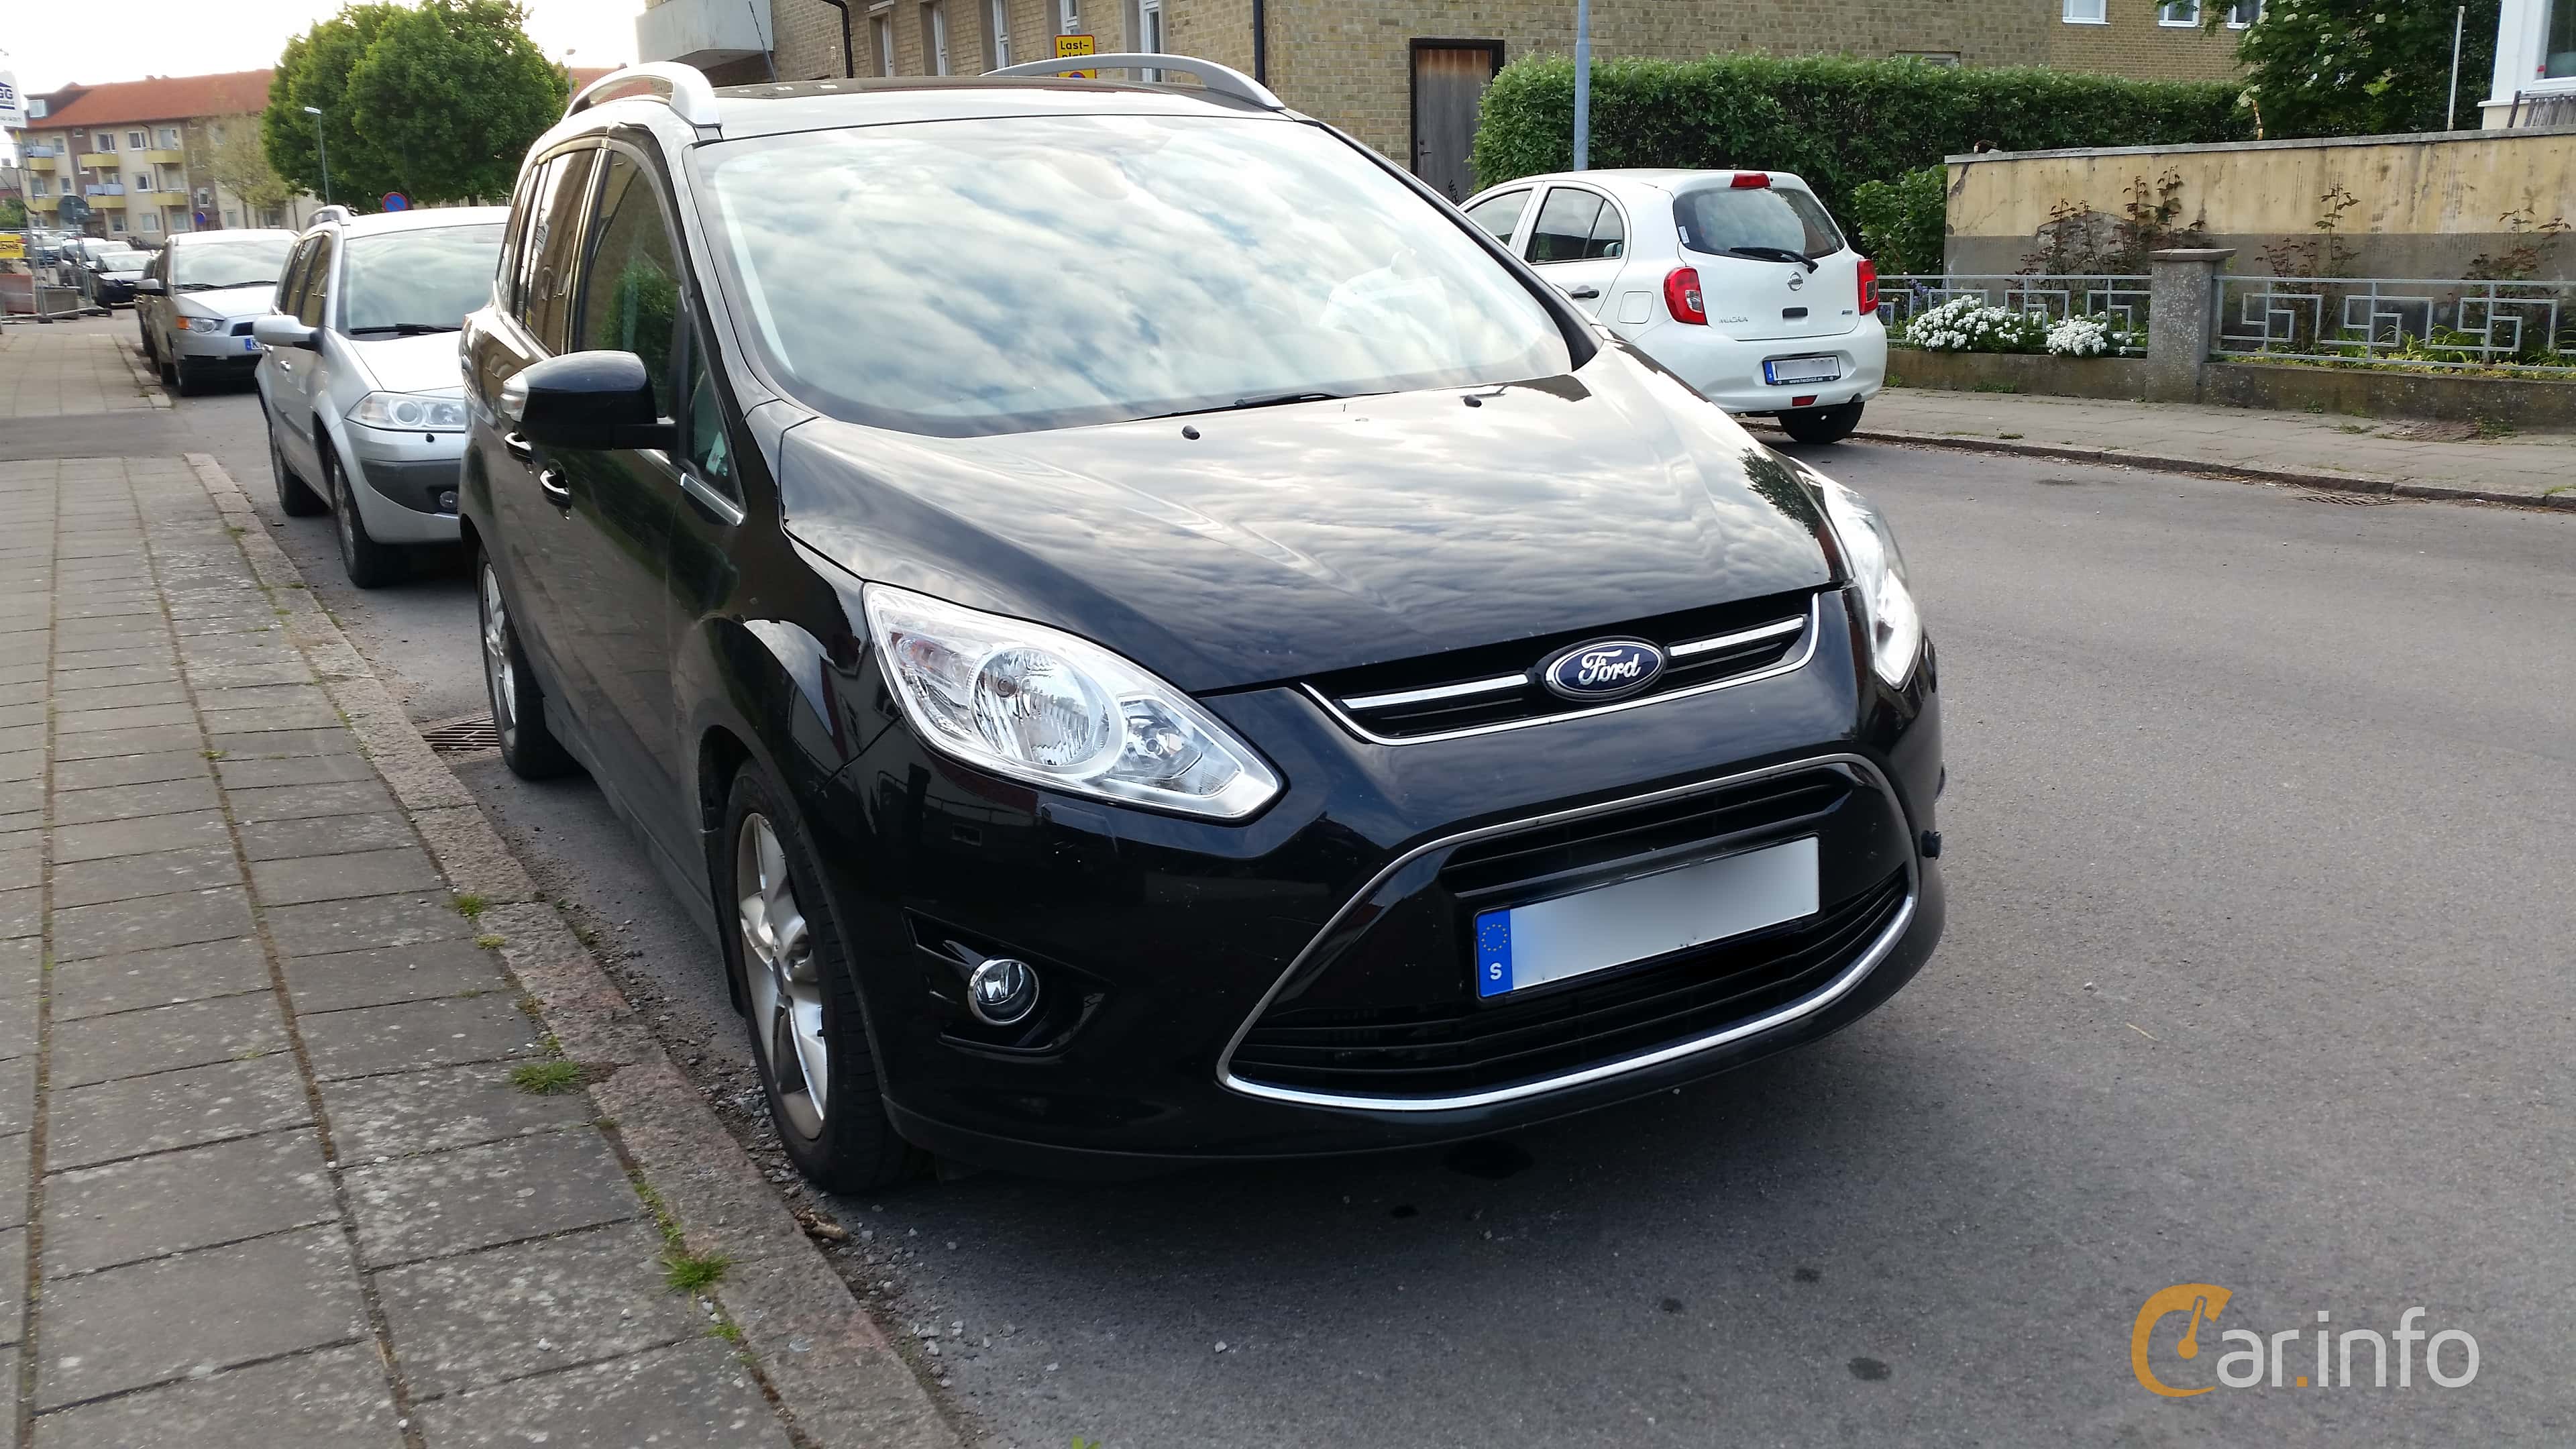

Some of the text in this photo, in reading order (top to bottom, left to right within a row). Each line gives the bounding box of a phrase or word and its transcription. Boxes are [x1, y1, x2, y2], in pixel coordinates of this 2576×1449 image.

[1060, 40, 1089, 50] Last-
[1578, 649, 1642, 686] Ford
[1489, 962, 1502, 980] S
